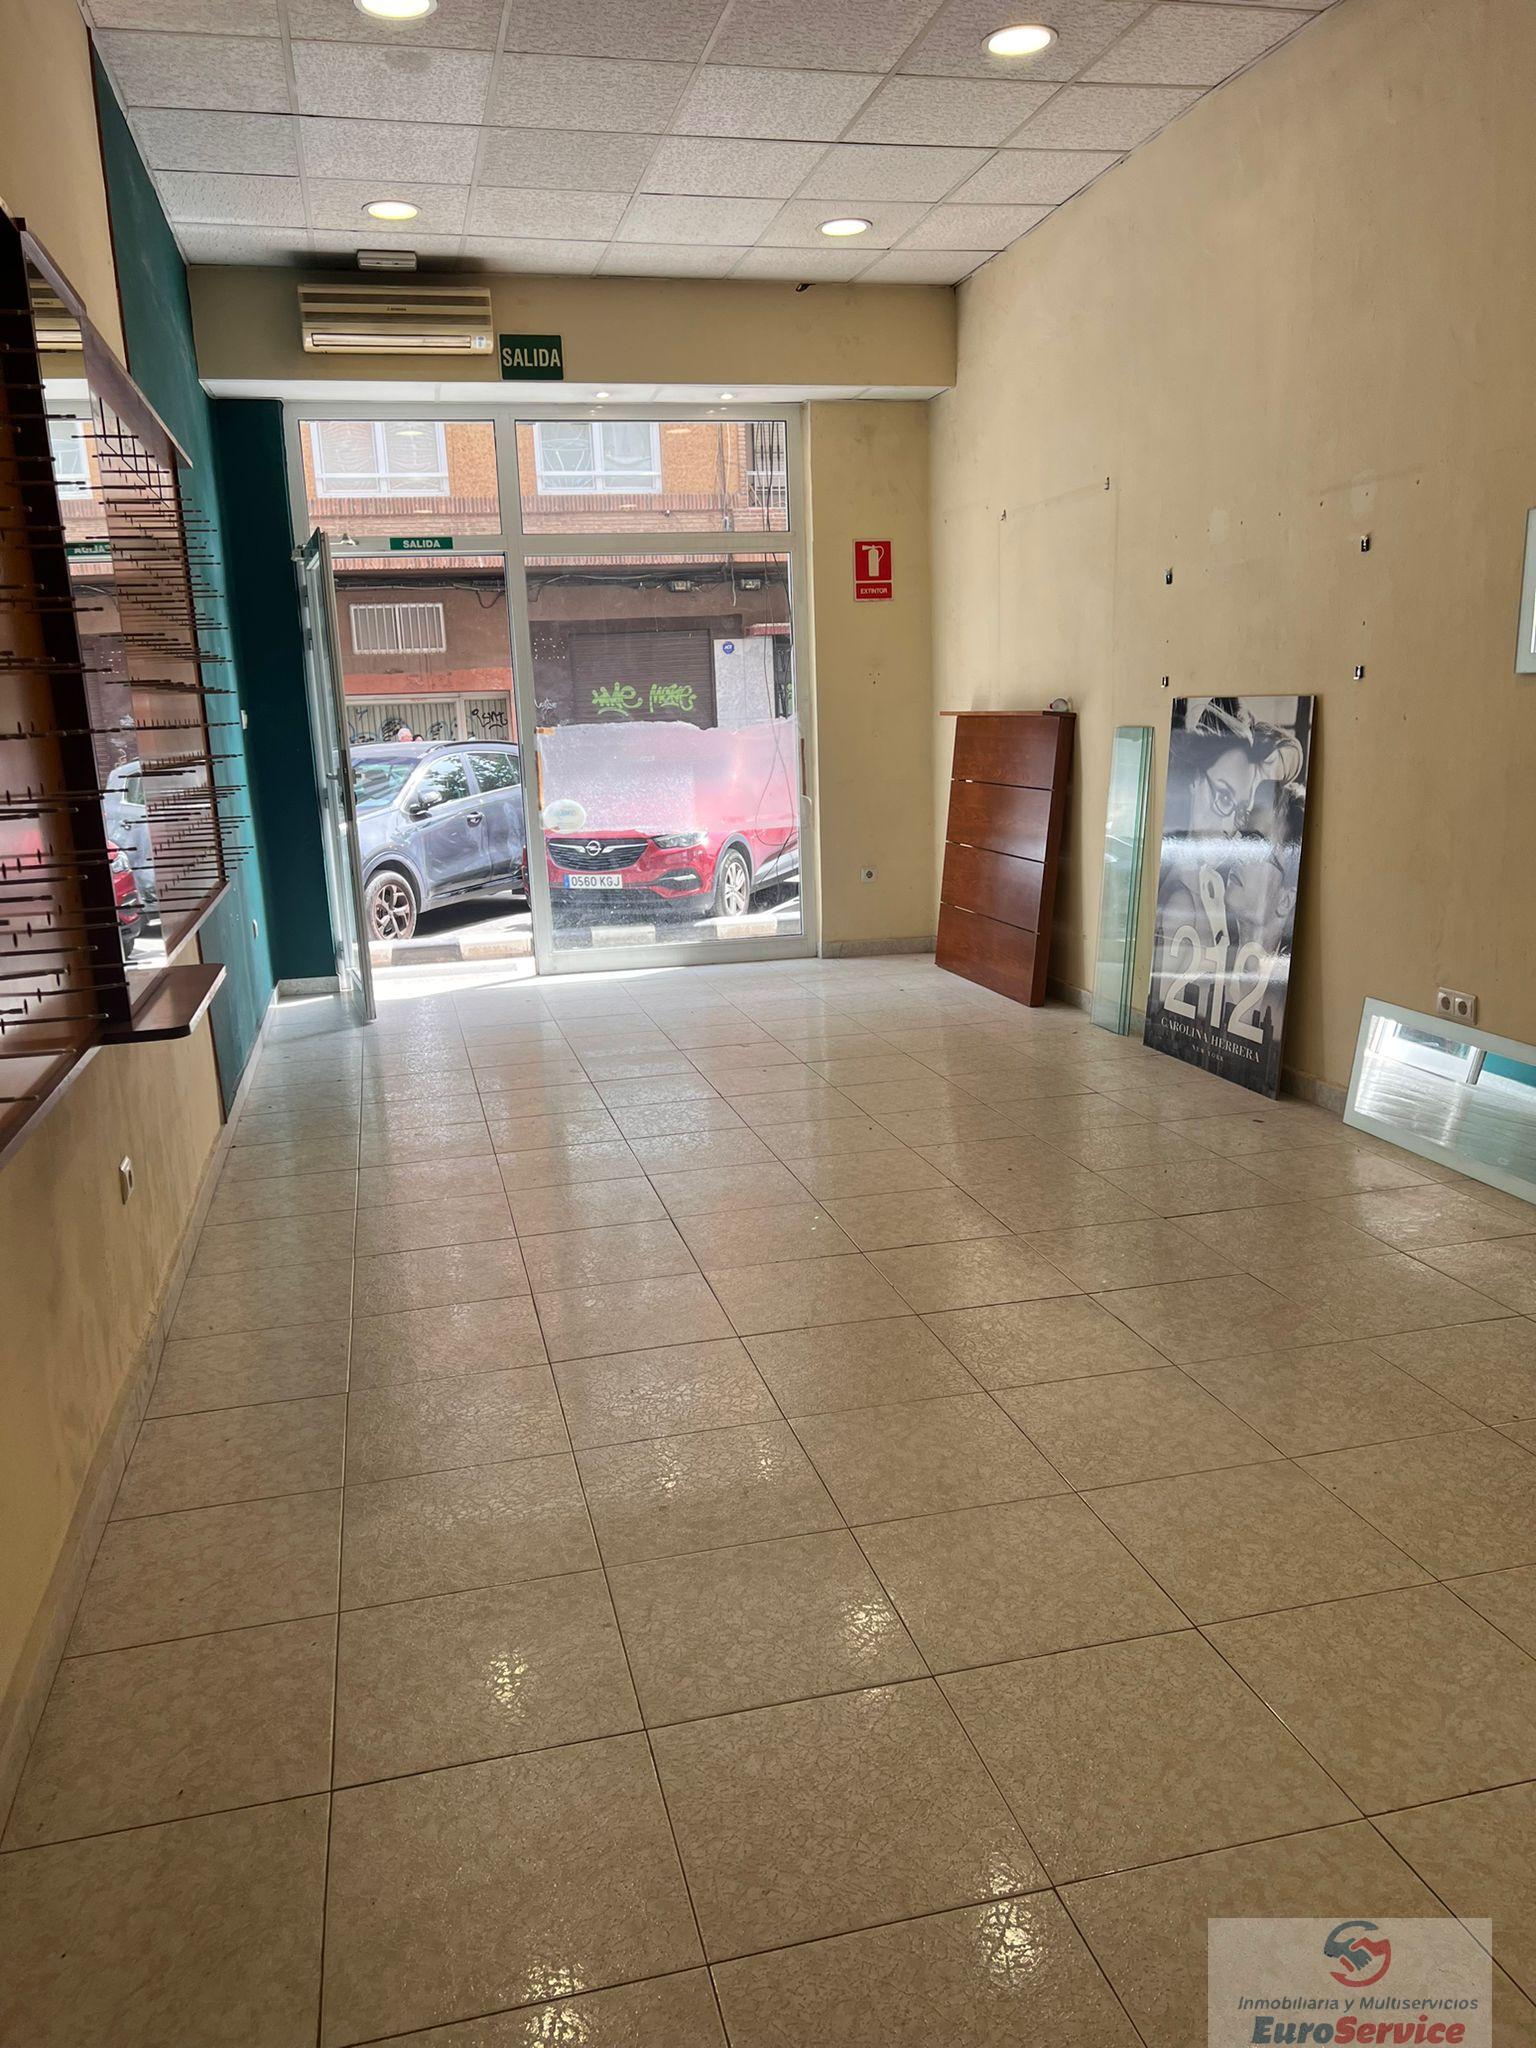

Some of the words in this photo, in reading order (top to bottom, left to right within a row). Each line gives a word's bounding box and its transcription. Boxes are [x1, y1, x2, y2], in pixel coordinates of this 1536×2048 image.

[502, 348, 561, 368] SALIDA
[402, 539, 441, 549] SALIDA
[860, 587, 888, 595] EXTINTOR
[571, 876, 597, 887] 0560
[600, 876, 620, 887] KGJ
[1163, 925, 1272, 1045] 212
[1161, 1017, 1208, 1043] CAROLINA
[1211, 1034, 1260, 1062] HERRERA
